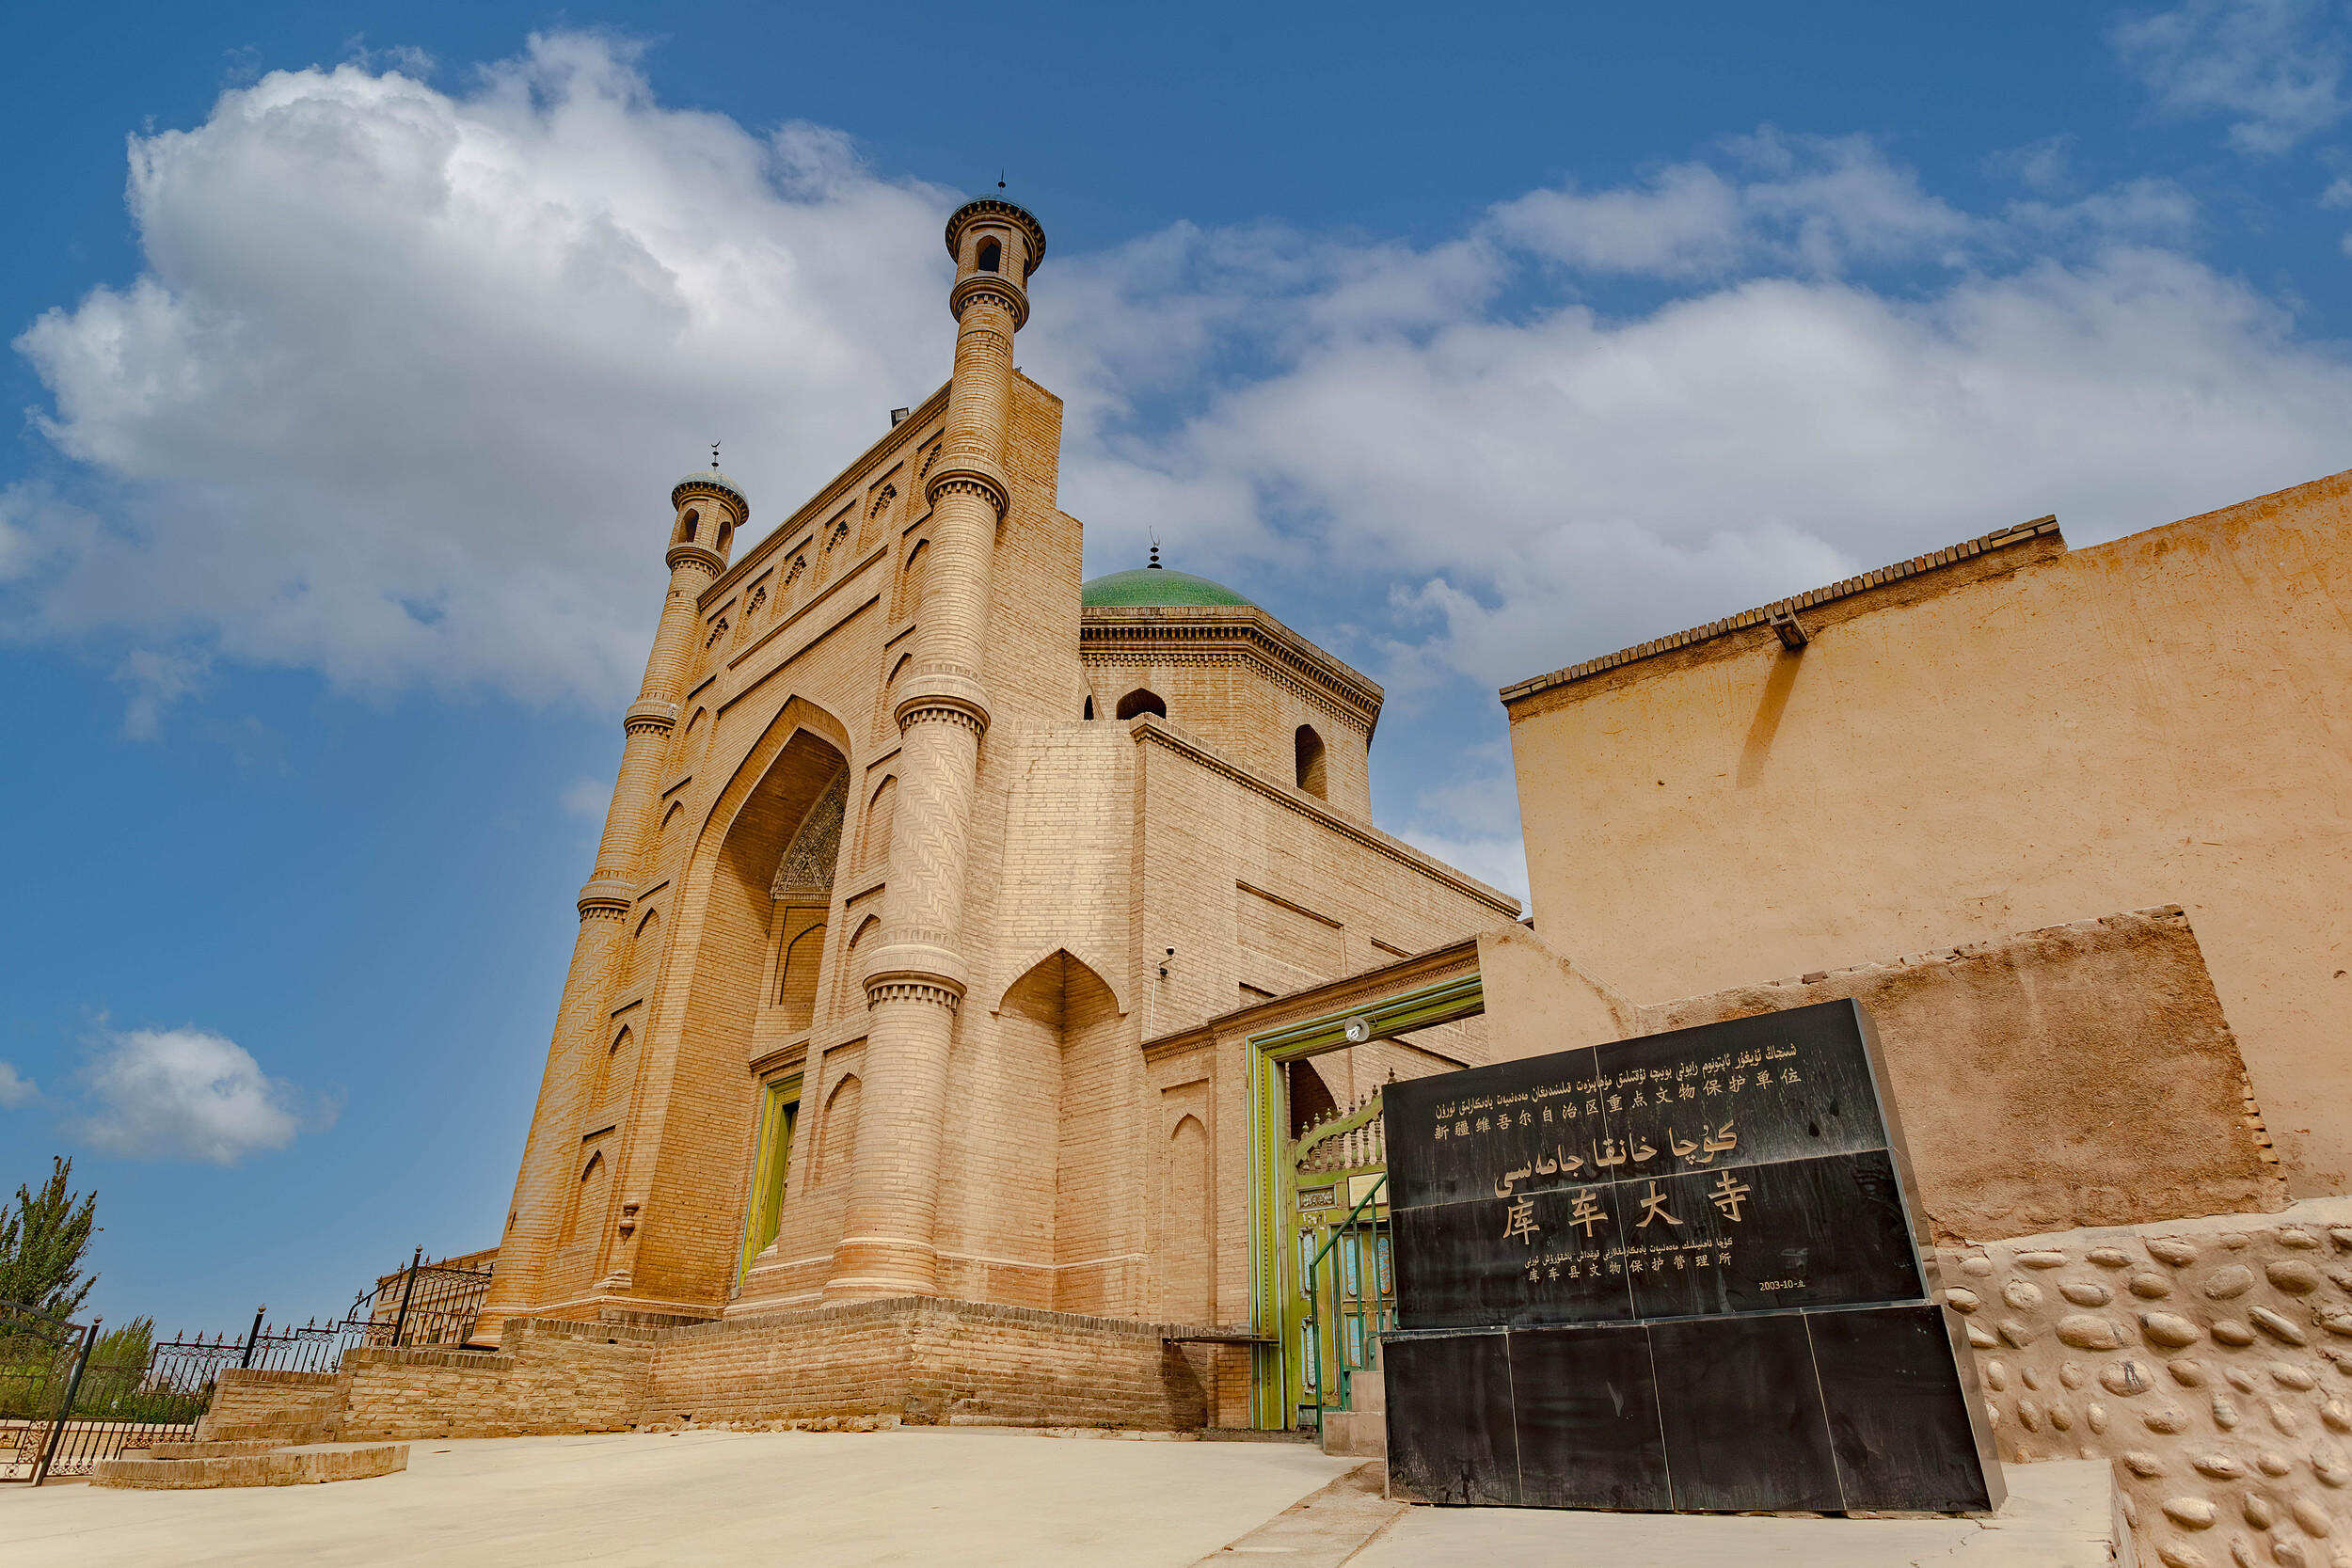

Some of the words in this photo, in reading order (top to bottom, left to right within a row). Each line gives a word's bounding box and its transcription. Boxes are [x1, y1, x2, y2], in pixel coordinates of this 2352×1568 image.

[1734, 1048, 1763, 1070] ئۇيغۇر
[1765, 1042, 1798, 1061] شىنجاڭ
[1434, 1067, 1802, 1141] 新疆维吾尔自治区重点文物保护单位
[1668, 1118, 1739, 1166] كۇچا
[1493, 1143, 1585, 1198] جامەسى
[1502, 1169, 1752, 1245] 库车大寺
[1528, 1252, 1732, 1283] 库车县文物保护管理所
